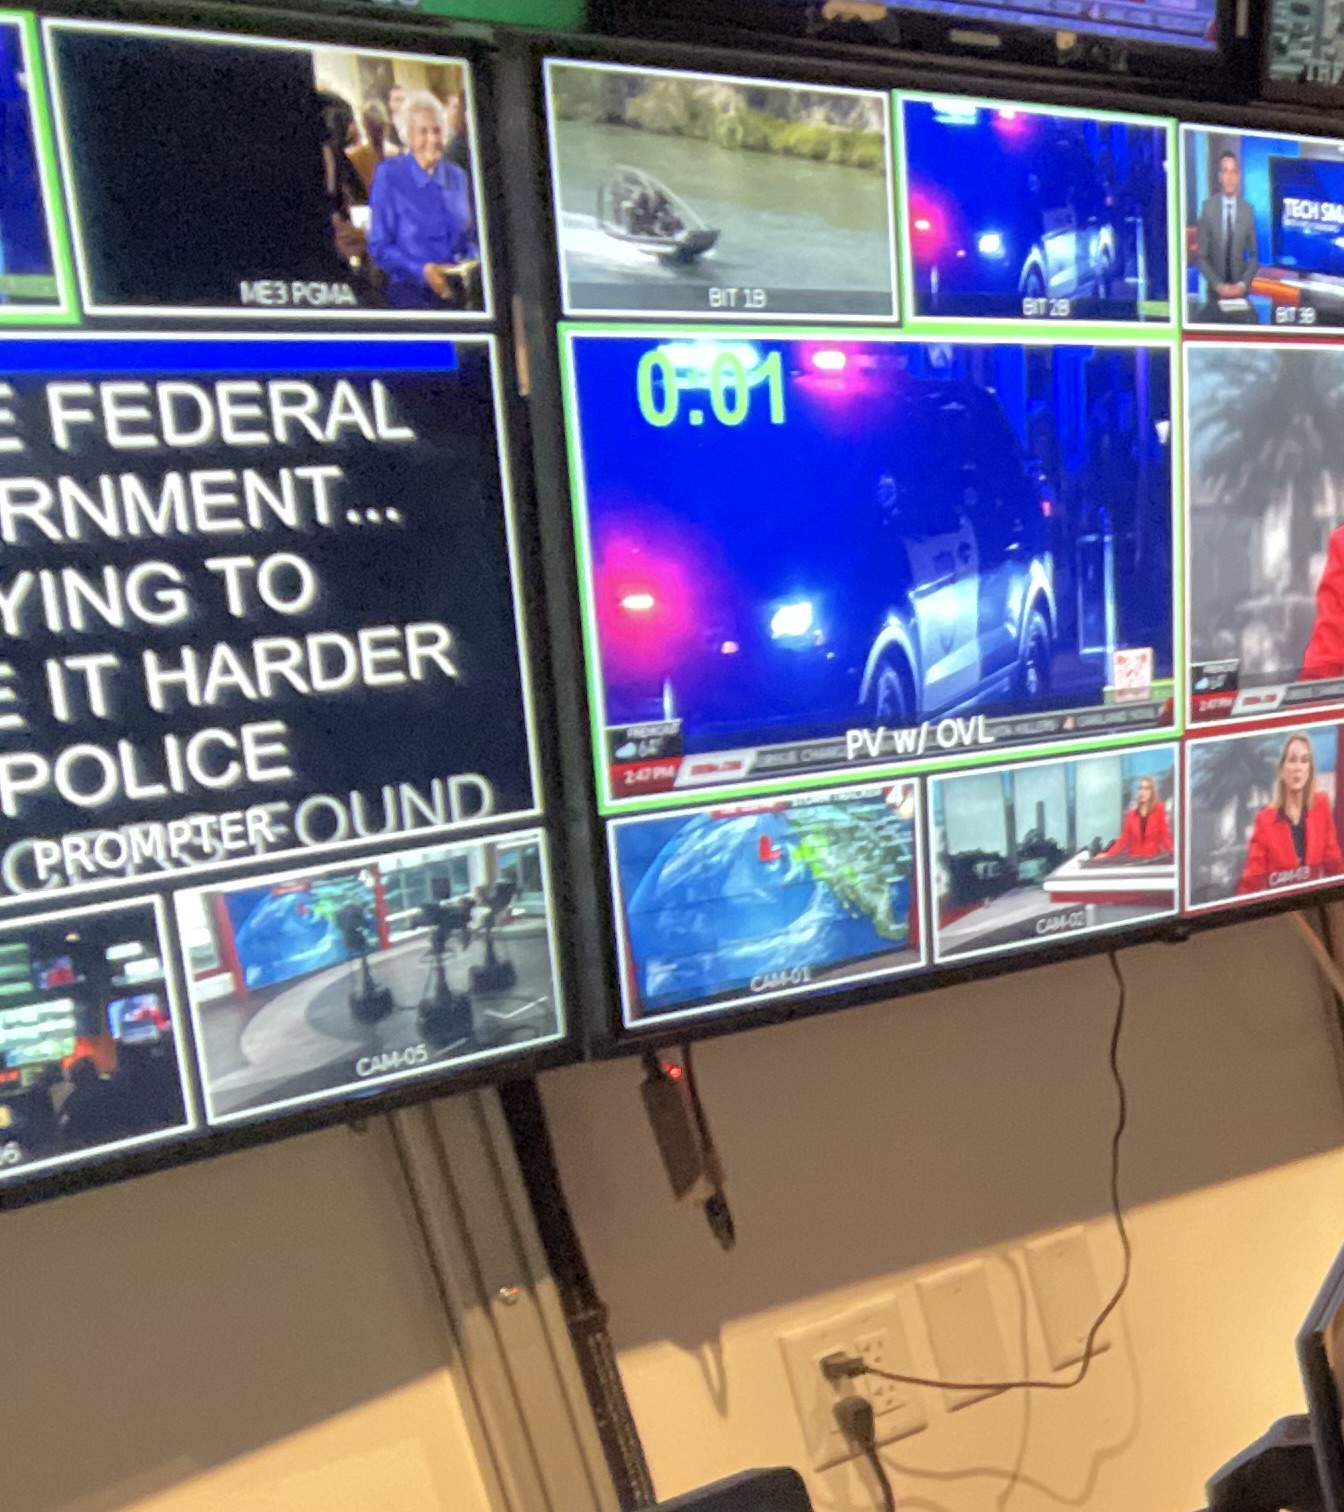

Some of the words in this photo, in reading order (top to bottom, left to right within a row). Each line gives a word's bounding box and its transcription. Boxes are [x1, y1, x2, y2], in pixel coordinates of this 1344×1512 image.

[1282, 197, 1319, 221] TECH
[708, 287, 740, 308] BIT
[1021, 297, 1047, 316] BIT
[46, 377, 416, 451] FEDERAL
[636, 350, 786, 428] 0:01
[204, 551, 317, 619] TO
[45, 652, 121, 723] IT
[142, 621, 459, 713] HARDER
[845, 726, 886, 760] PV
[892, 721, 930, 756] w/
[936, 714, 995, 750] OVL
[0, 719, 294, 819] POLICE
[32, 808, 277, 881] PROMPTER
[749, 965, 812, 992] CAM-01
[355, 1043, 428, 1077] CAM-05
